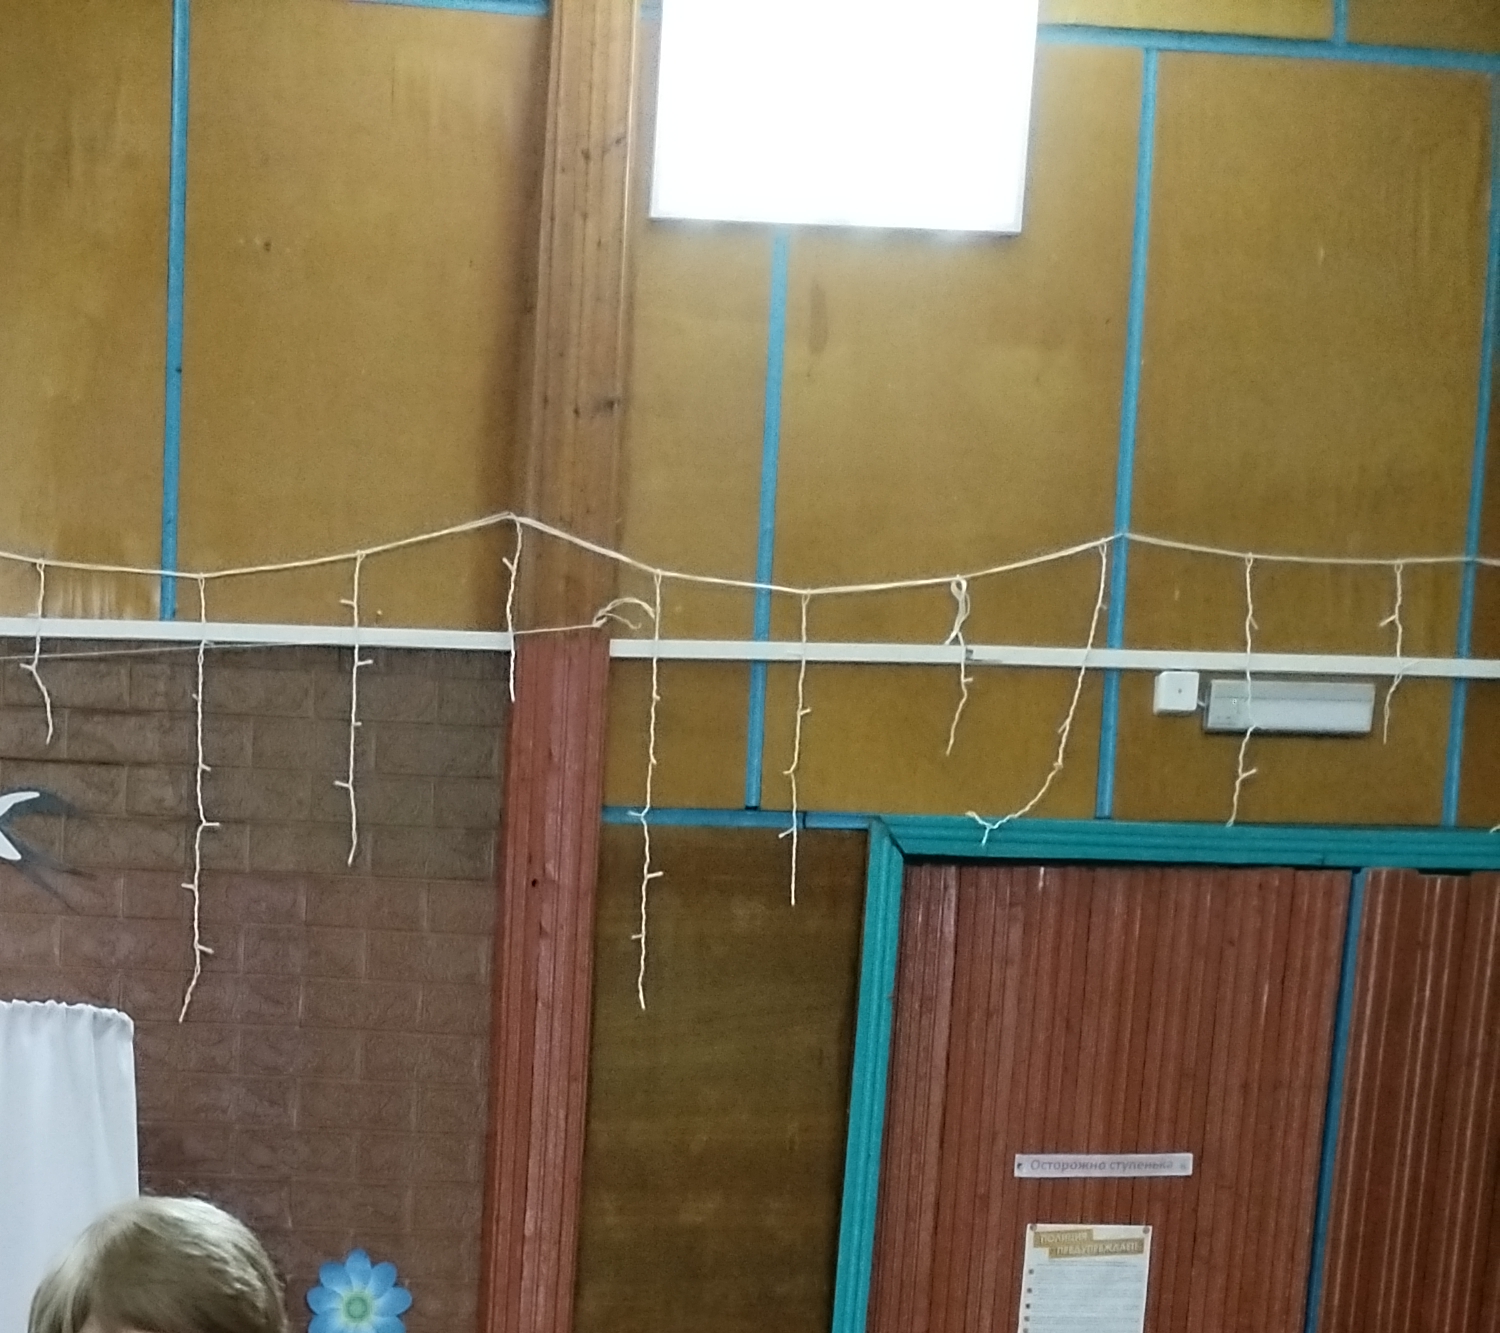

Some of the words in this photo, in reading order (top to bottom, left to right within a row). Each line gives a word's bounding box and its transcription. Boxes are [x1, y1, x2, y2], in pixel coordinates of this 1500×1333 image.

[1030, 1158, 1106, 1173] Осторожно
[1109, 1159, 1174, 1173] ступенька
[1040, 1231, 1088, 1244] ПОЛИЦИЯ
